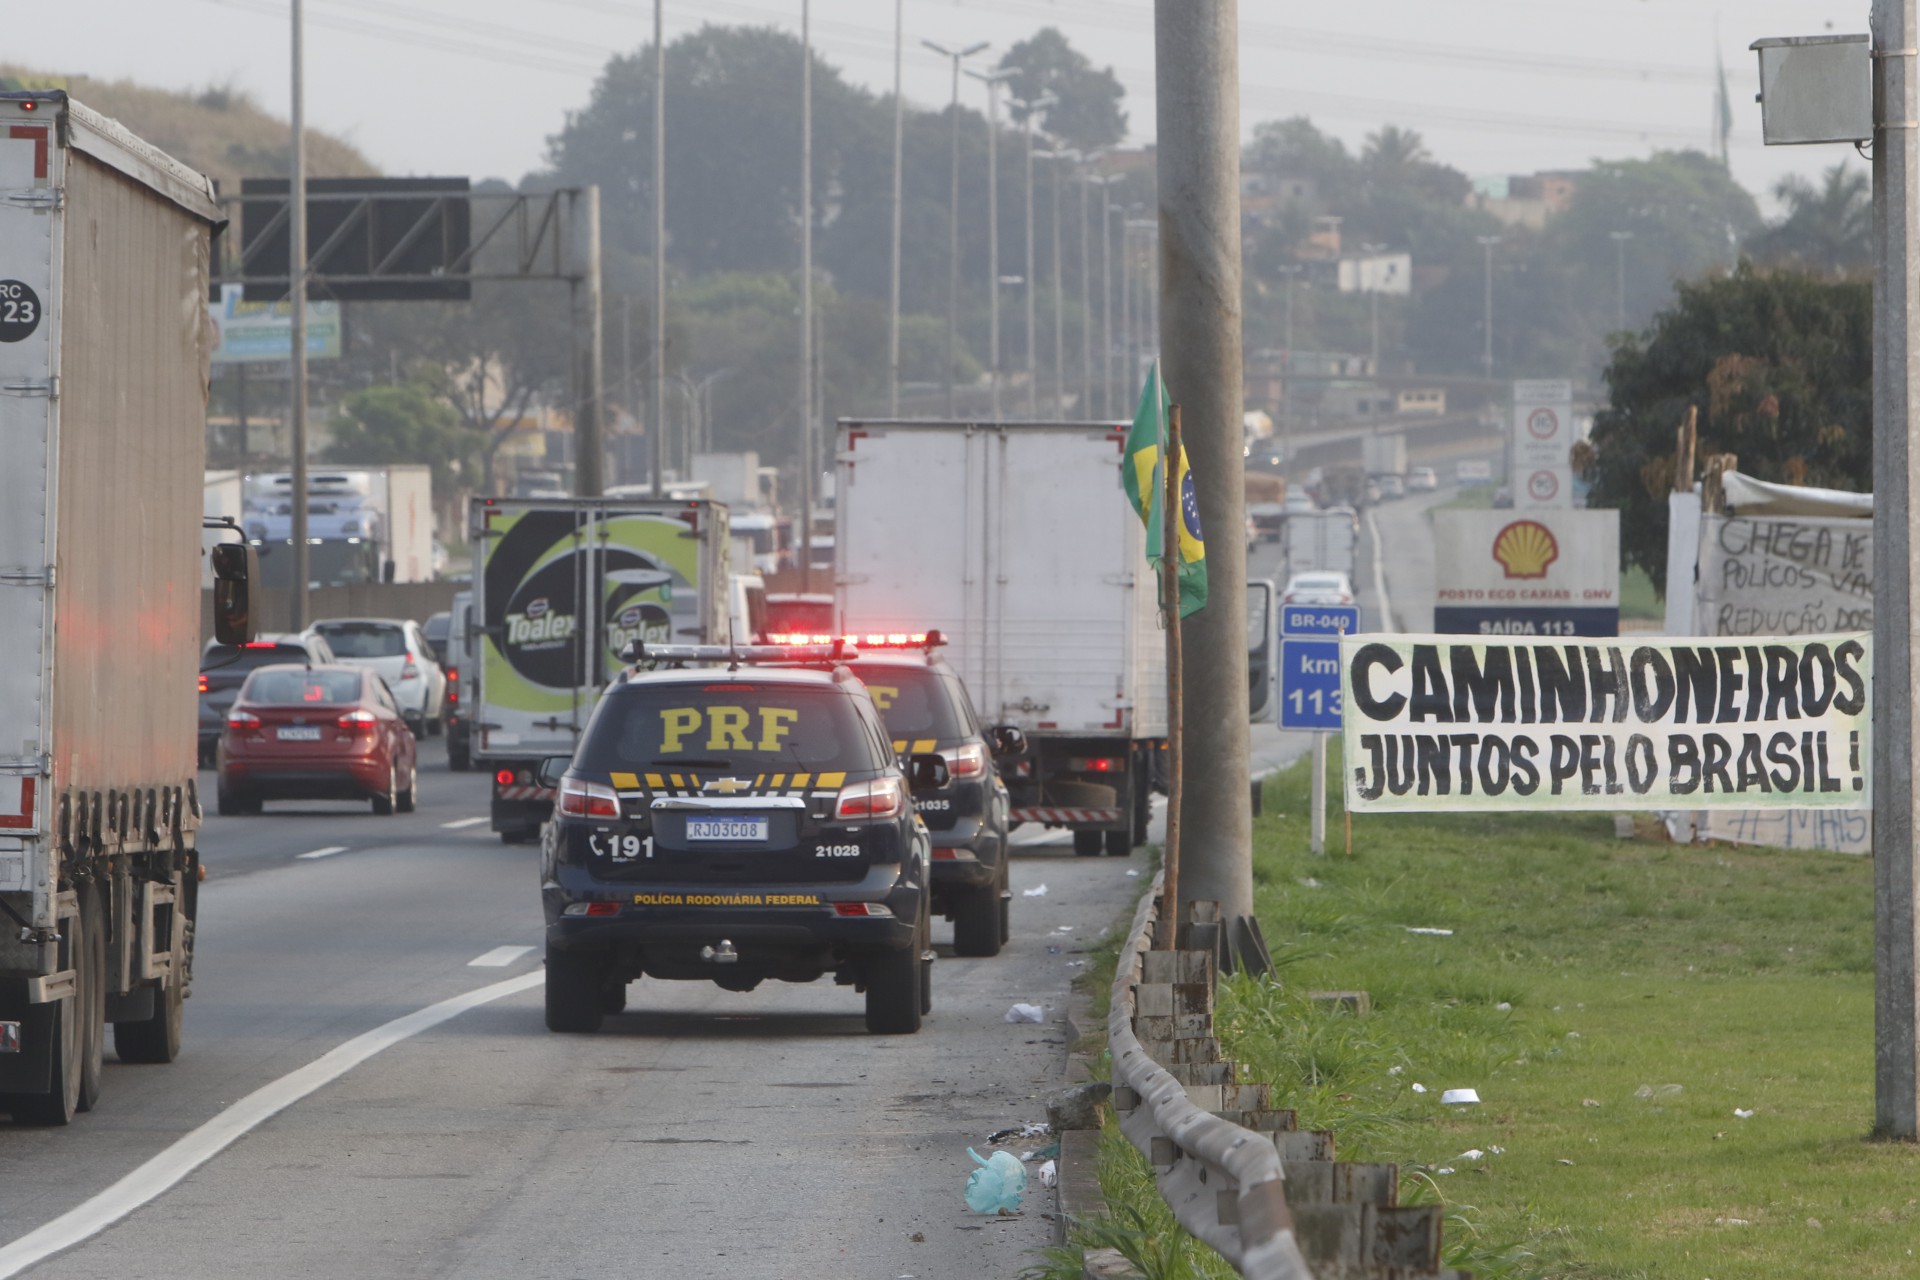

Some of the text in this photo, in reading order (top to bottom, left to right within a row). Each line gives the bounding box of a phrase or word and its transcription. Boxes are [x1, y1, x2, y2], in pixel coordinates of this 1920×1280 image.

[0, 300, 35, 323] 23
[1719, 518, 1869, 569] CHEGA DE
[1438, 589, 1484, 600] POSTO
[1488, 589, 1516, 600] ECO
[1520, 589, 1571, 600] CAXIAS
[1582, 589, 1612, 600] GNV
[505, 608, 577, 644] Toalex
[1290, 613, 1351, 629] BR-040
[1479, 617, 1575, 636] SAÍDA 113
[1301, 654, 1339, 674] km
[1350, 639, 1867, 725] CAMINHONEIROS
[659, 705, 798, 753] PRF
[1354, 733, 1541, 800] JUNTOS
[1549, 732, 1659, 795] PELO
[607, 834, 654, 858] 191
[815, 844, 861, 857] 21028
[634, 893, 820, 905] POLÍCIA RODOVIÁRIA FEDERAL
